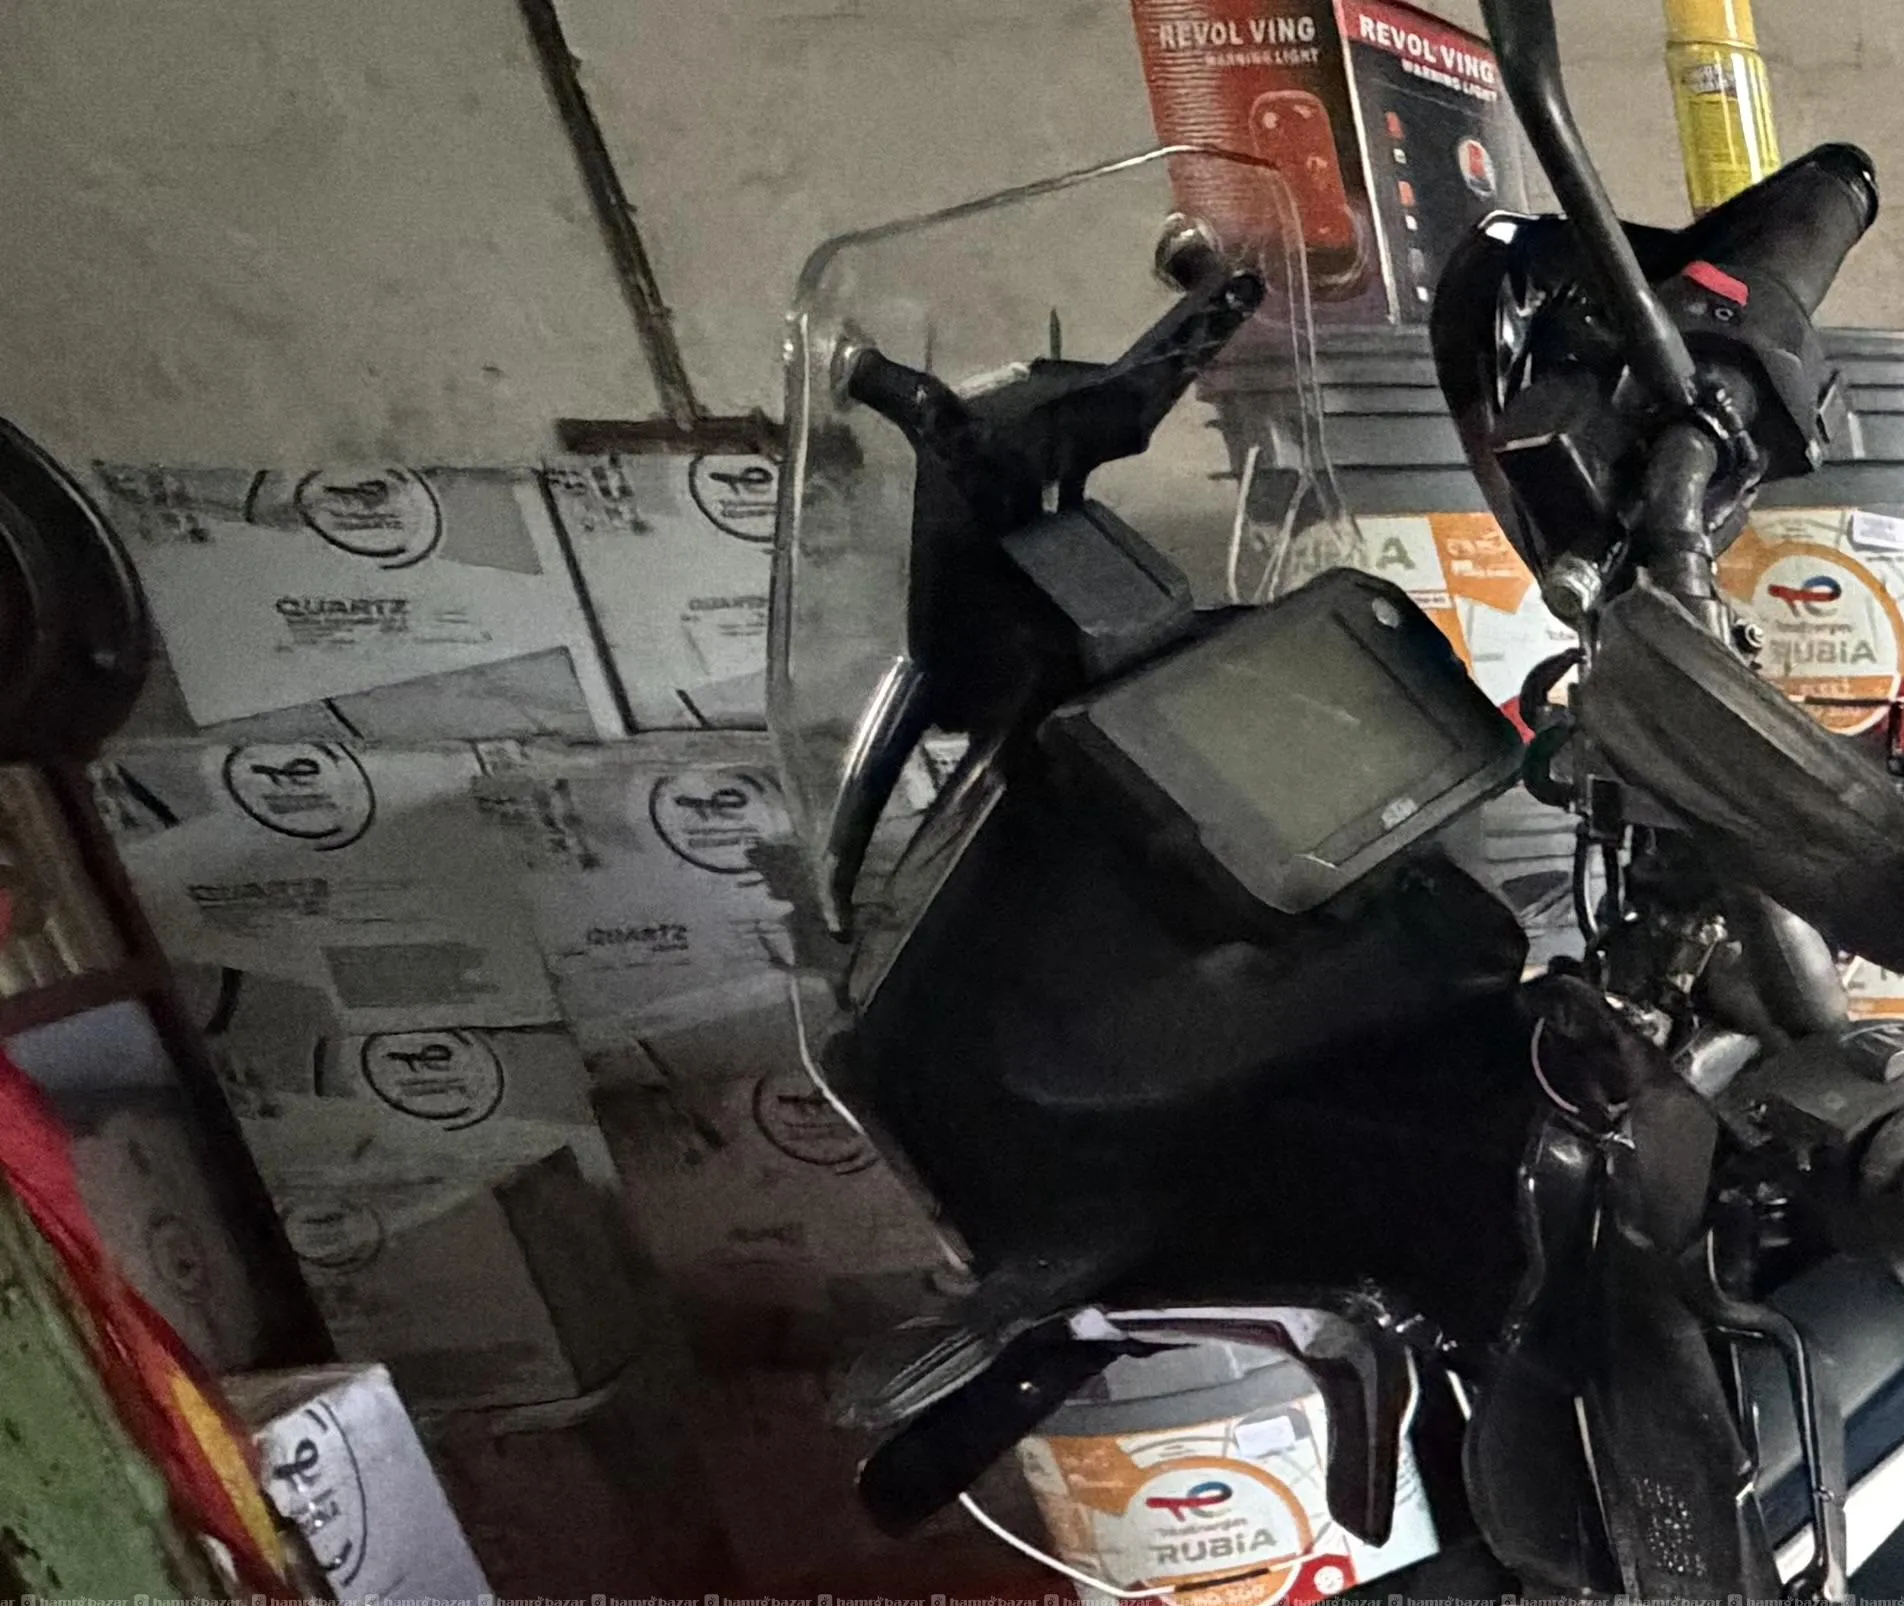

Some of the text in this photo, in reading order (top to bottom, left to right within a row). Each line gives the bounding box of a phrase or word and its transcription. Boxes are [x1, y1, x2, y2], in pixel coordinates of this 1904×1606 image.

[1160, 16, 1316, 50] REVOL VING
[1360, 15, 1495, 83] REVOL VING
